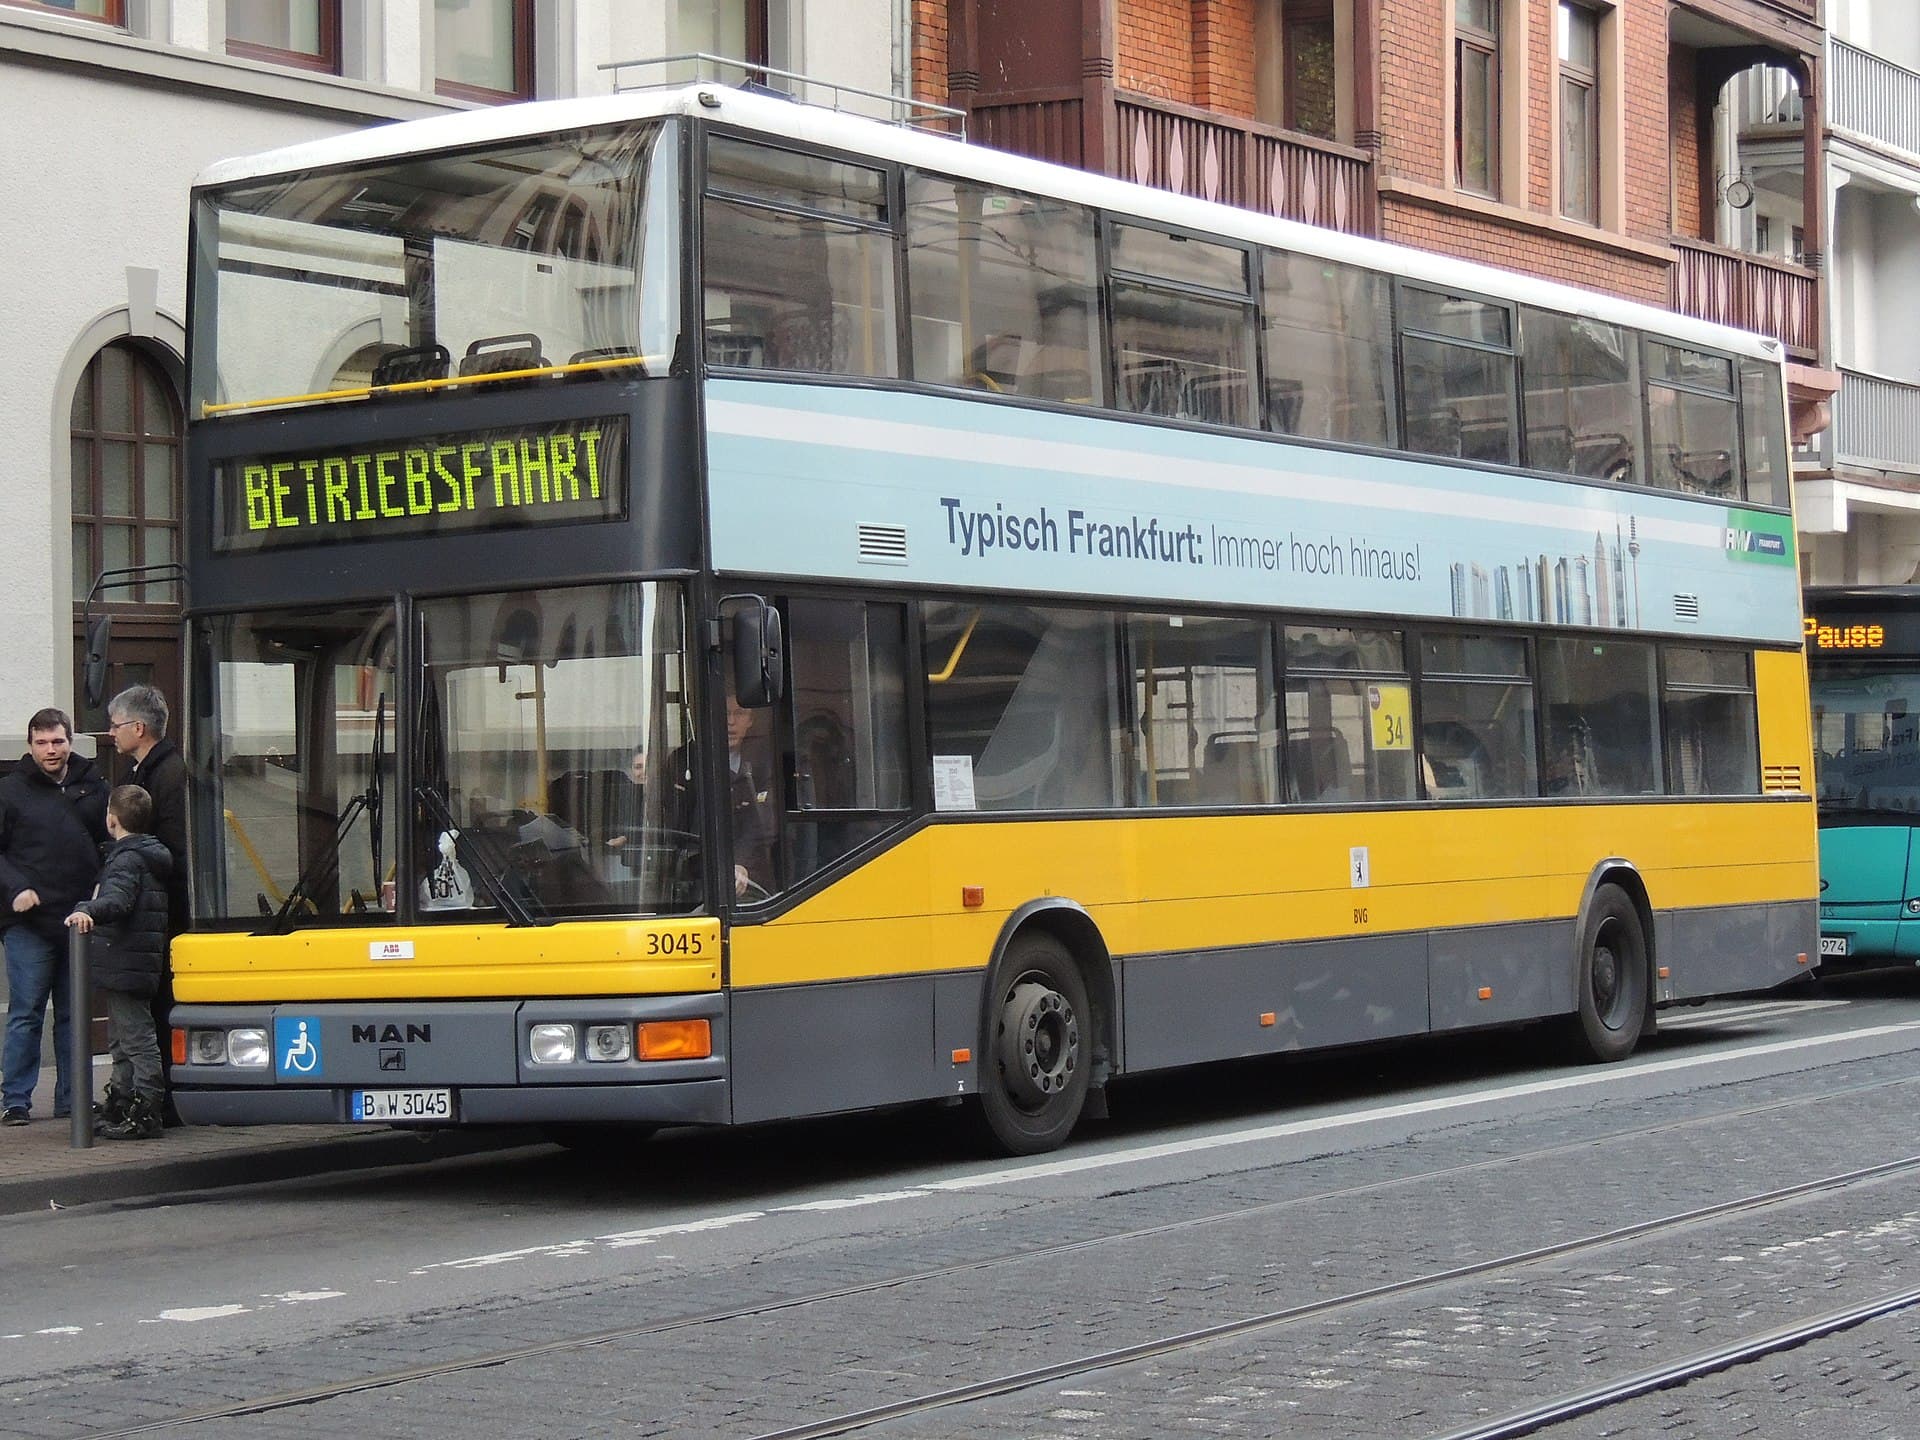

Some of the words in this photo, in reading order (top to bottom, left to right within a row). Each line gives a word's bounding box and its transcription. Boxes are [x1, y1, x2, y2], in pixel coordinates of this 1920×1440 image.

[244, 431, 601, 530] BETRIEBSFAHRT
[940, 497, 1058, 557] Typisch
[1068, 510, 1204, 564] Frankfurt:
[1212, 524, 1282, 571] Immer
[1290, 532, 1343, 576] hoch
[1350, 538, 1421, 581] hinaus!
[1385, 714, 1403, 745] 34
[1353, 908, 1368, 924] BVG
[647, 933, 702, 955] 3045
[1822, 940, 1844, 953] 974
[352, 1024, 431, 1043] MAN
